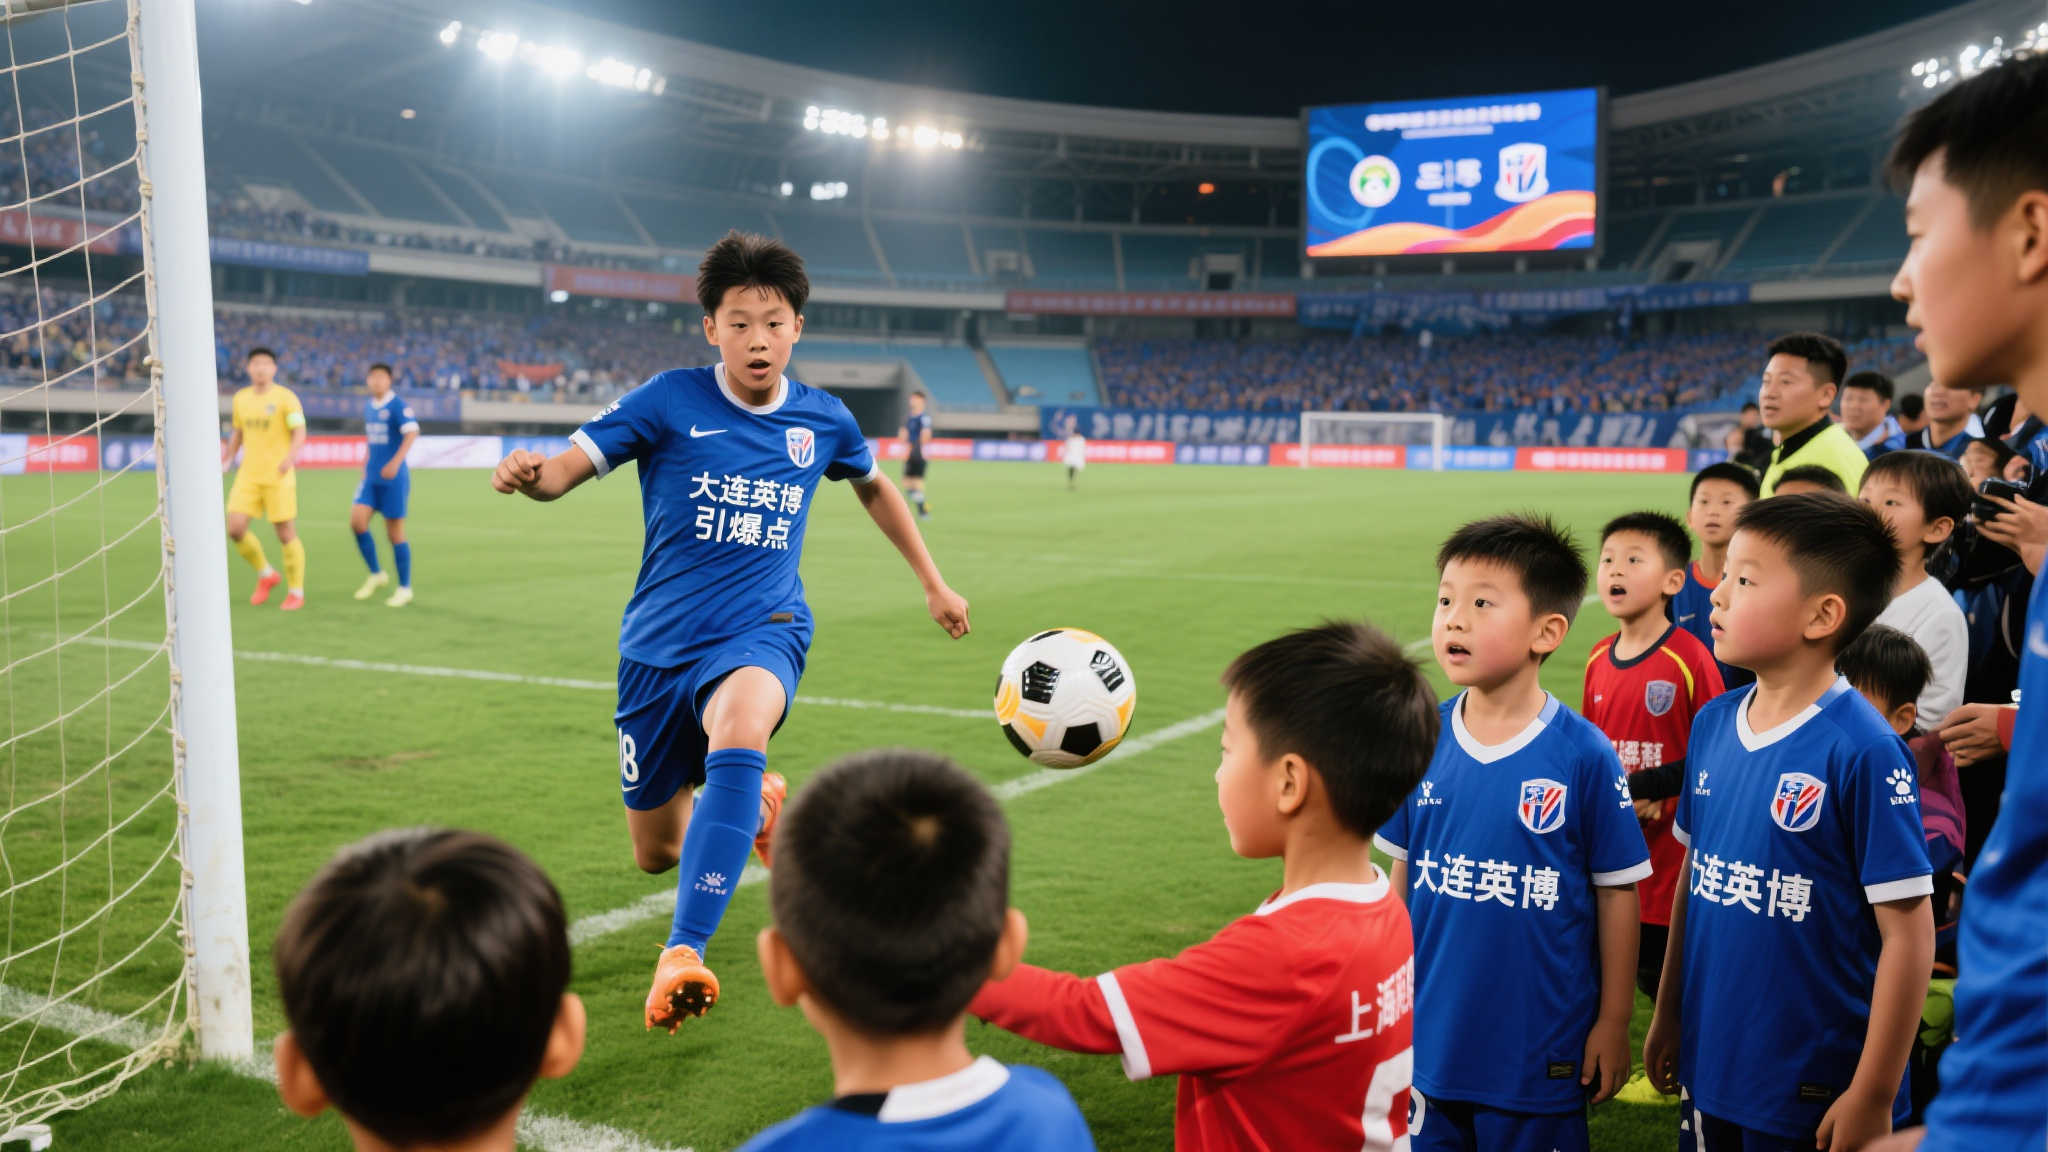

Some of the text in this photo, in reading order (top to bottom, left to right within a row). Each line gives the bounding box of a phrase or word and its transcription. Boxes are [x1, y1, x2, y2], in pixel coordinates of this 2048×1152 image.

[689, 471, 804, 515] 大连英博
[695, 505, 792, 550] 引爆点
[1414, 849, 1560, 911] 大连英博
